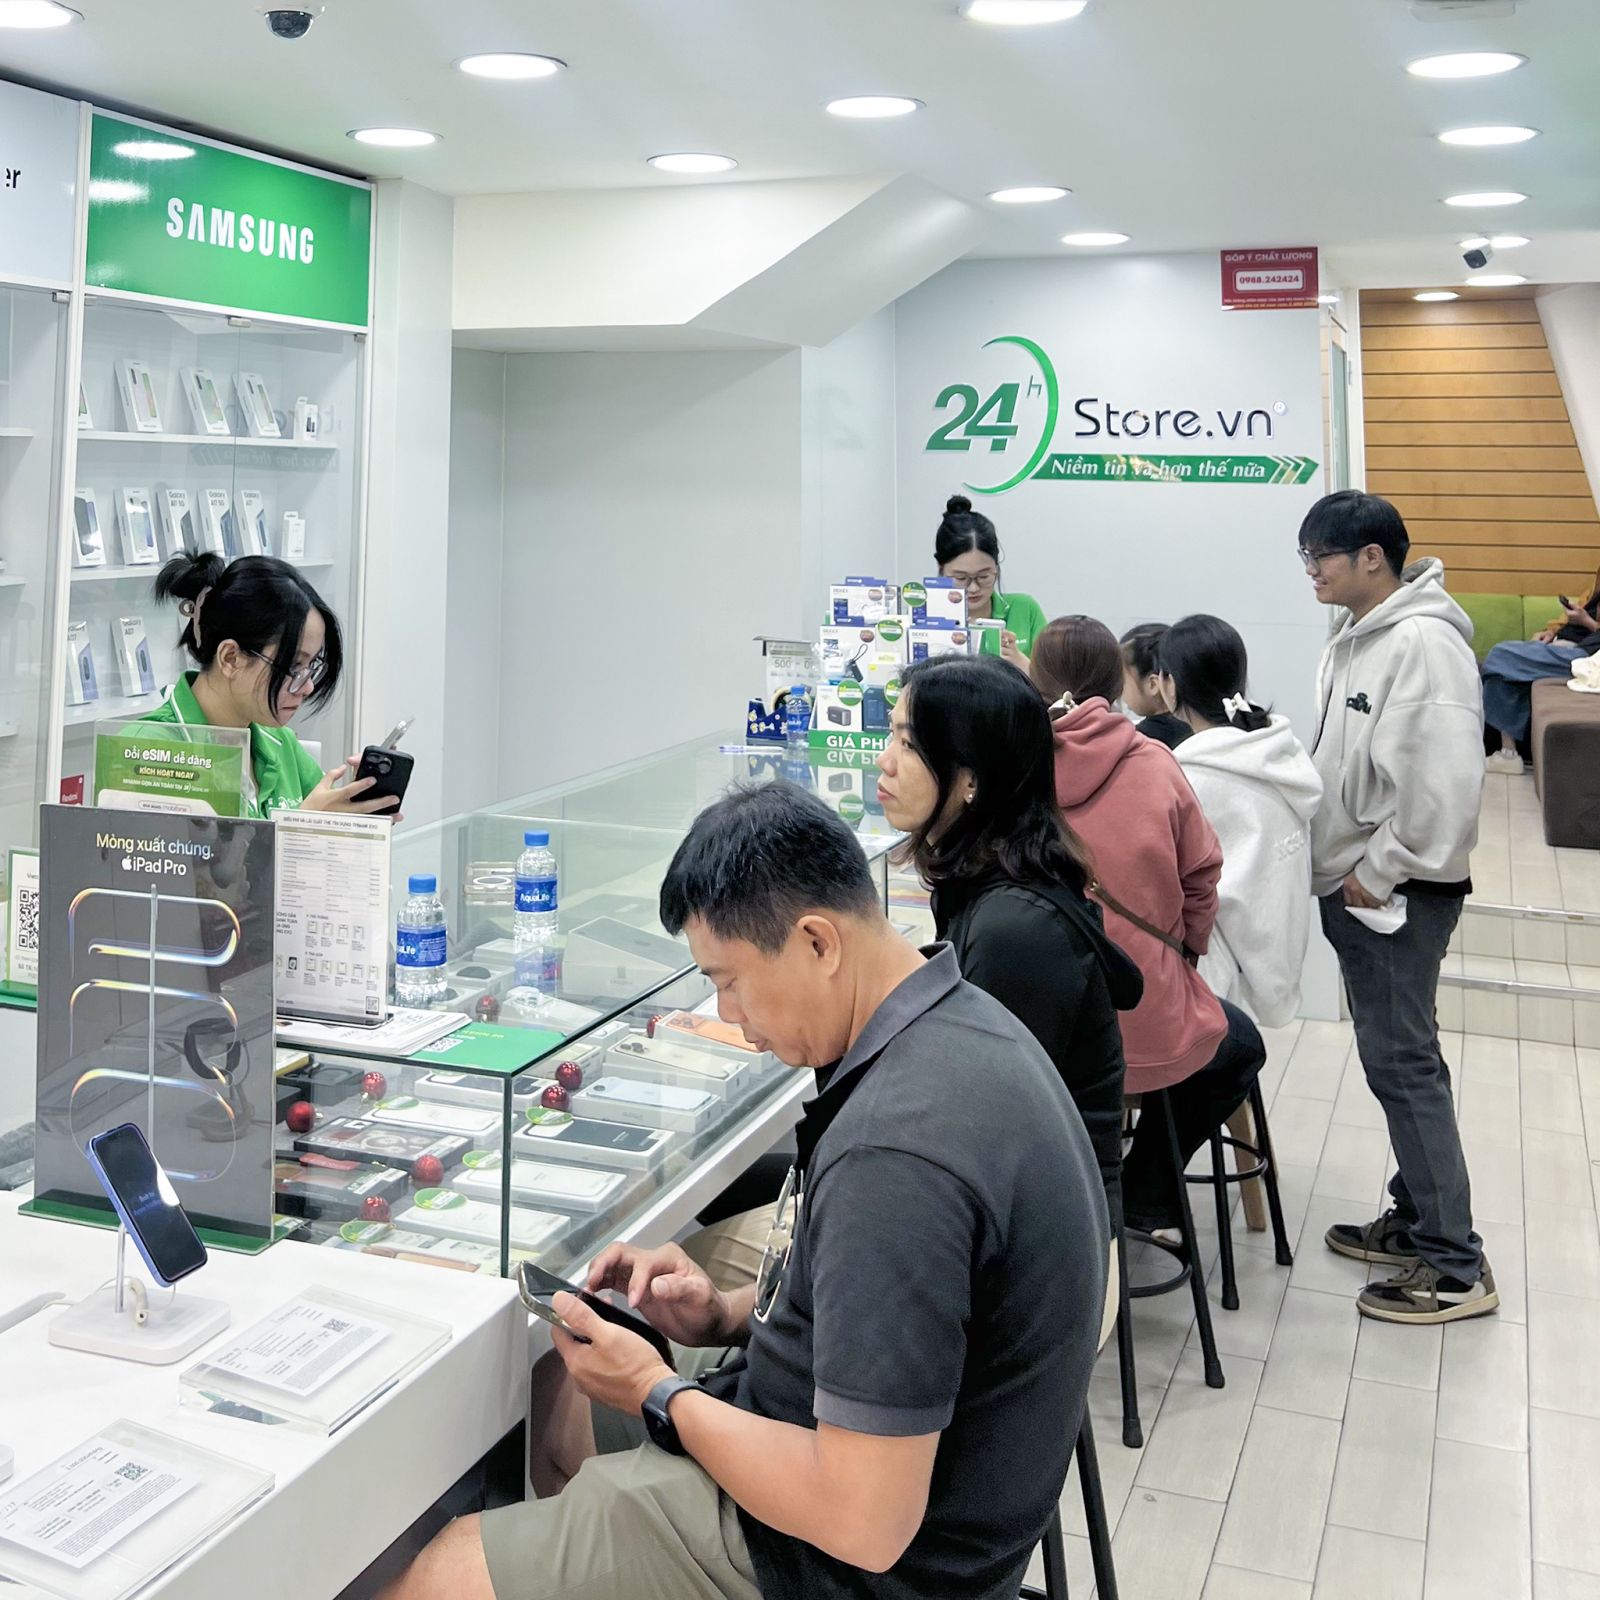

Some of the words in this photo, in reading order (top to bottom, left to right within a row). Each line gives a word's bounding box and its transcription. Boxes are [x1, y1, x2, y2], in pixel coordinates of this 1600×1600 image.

[166, 197, 314, 264] SAMSUNG
[1074, 397, 1273, 437] Store.vn
[1051, 458, 1098, 475] Niềm
[1104, 460, 1127, 476] tin
[1158, 459, 1192, 477] hơn
[1198, 457, 1231, 477] thế
[1232, 459, 1266, 477] nữa
[826, 733, 856, 748] GIÁ
[124, 745, 140, 760] Đổi
[142, 748, 171, 763] eSIM
[173, 750, 186, 764] dễ
[187, 754, 212, 769] dàng
[139, 766, 156, 776] KÍCH
[156, 769, 174, 779] HOẠT
[175, 770, 195, 780] NGAY
[96, 832, 134, 853] Mỏng
[137, 835, 166, 853] xuất
[168, 840, 214, 860] chúng.
[133, 857, 161, 874] iPad
[164, 859, 187, 876] Pro
